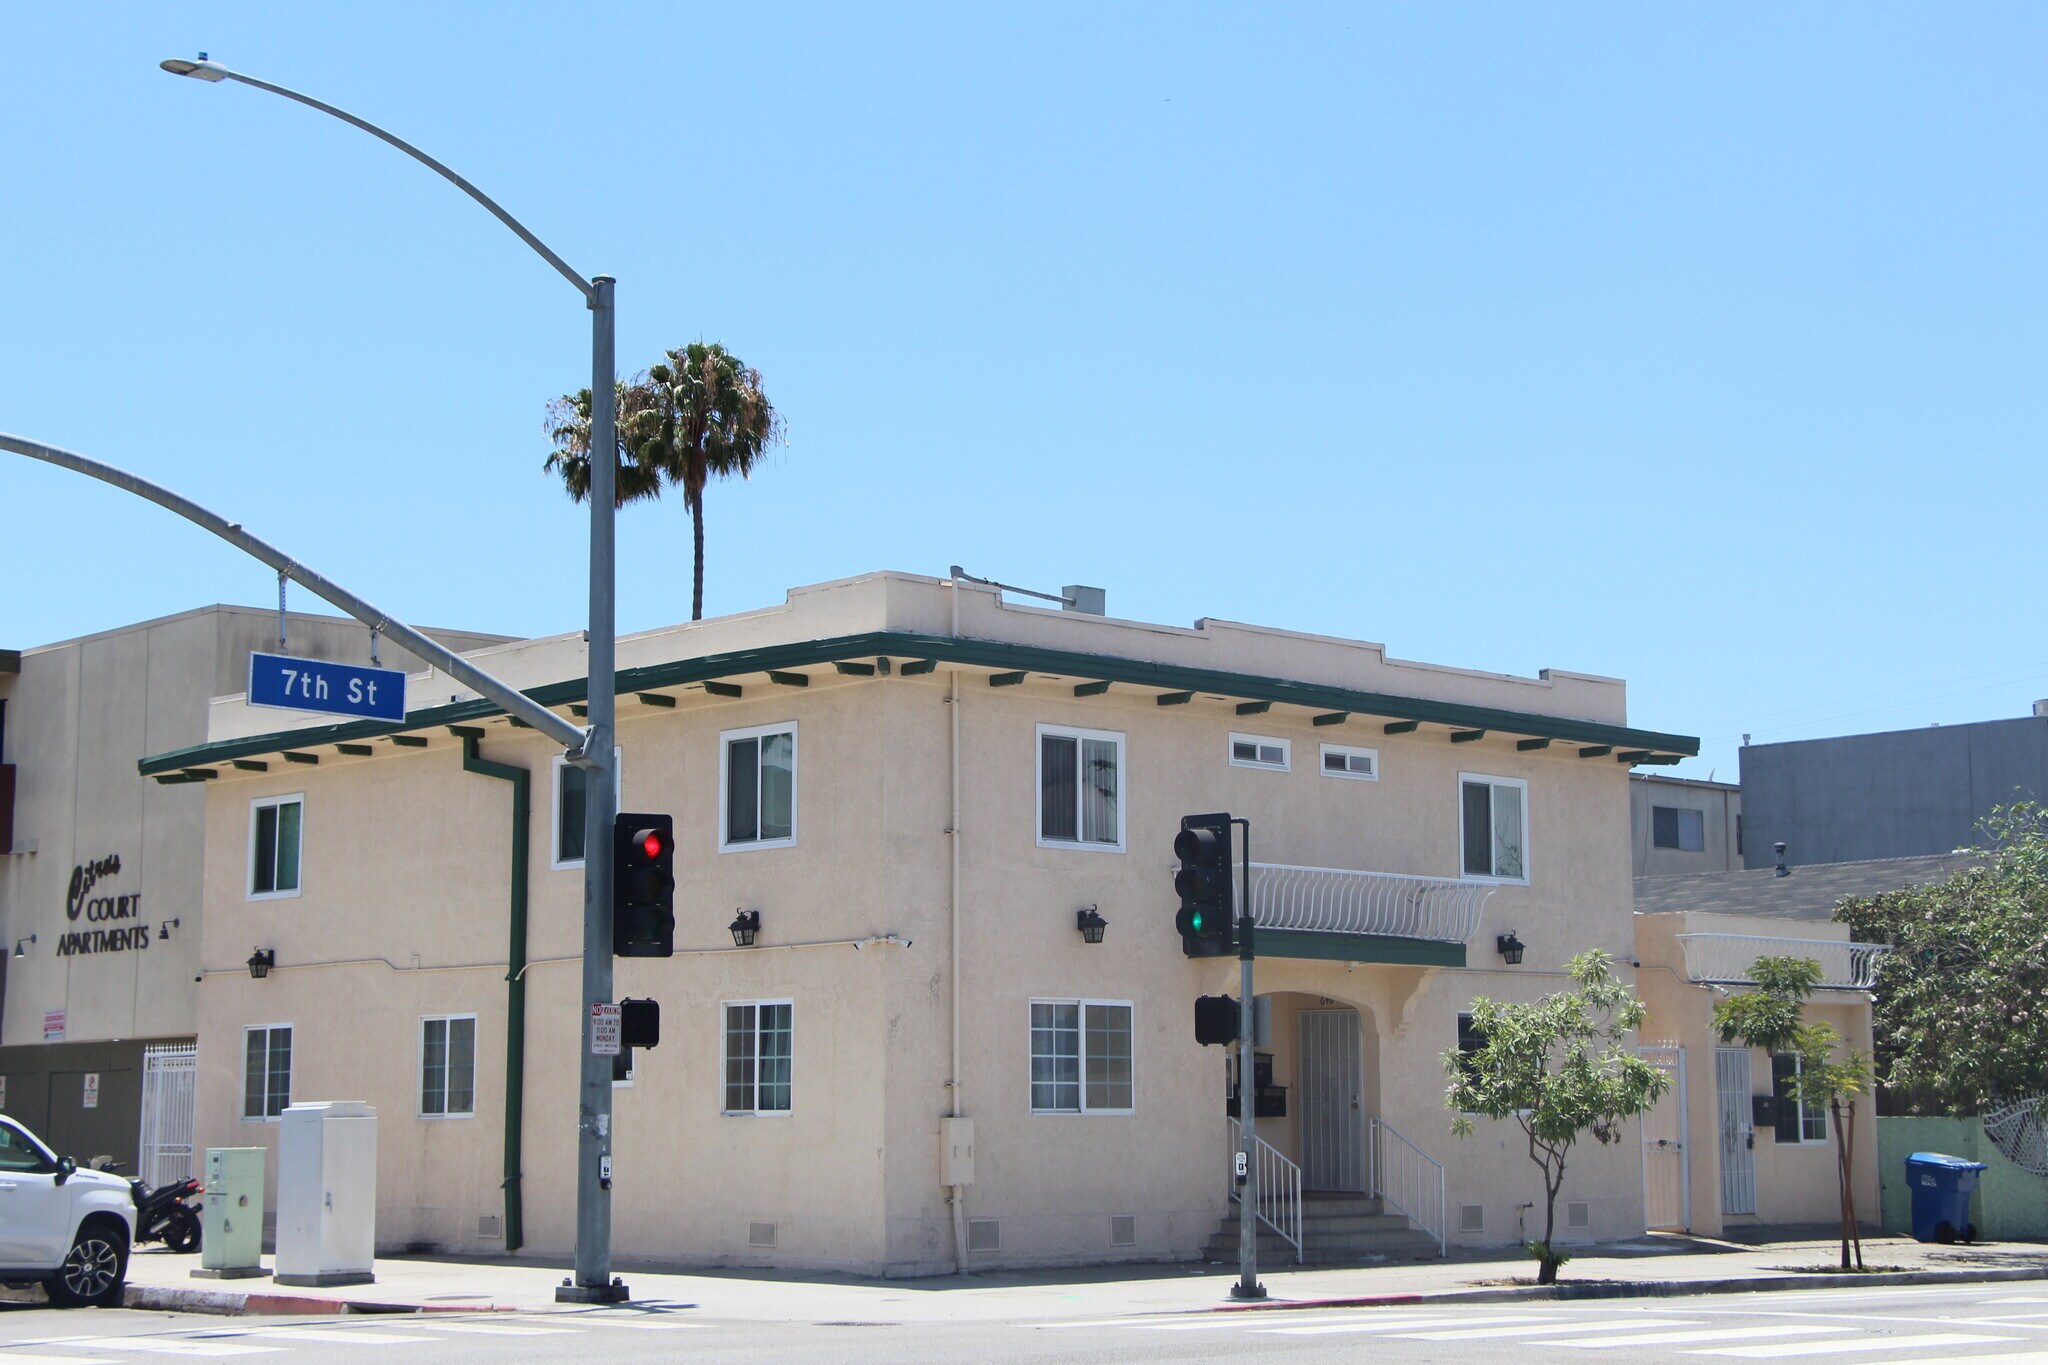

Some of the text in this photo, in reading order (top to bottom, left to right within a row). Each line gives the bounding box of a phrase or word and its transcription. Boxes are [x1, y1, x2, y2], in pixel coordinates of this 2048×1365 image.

[281, 669, 377, 706] 7th St
[87, 894, 141, 922] COURT
[56, 925, 149, 956] APARTMENTS
[592, 1005, 620, 1015] NO PARKING
